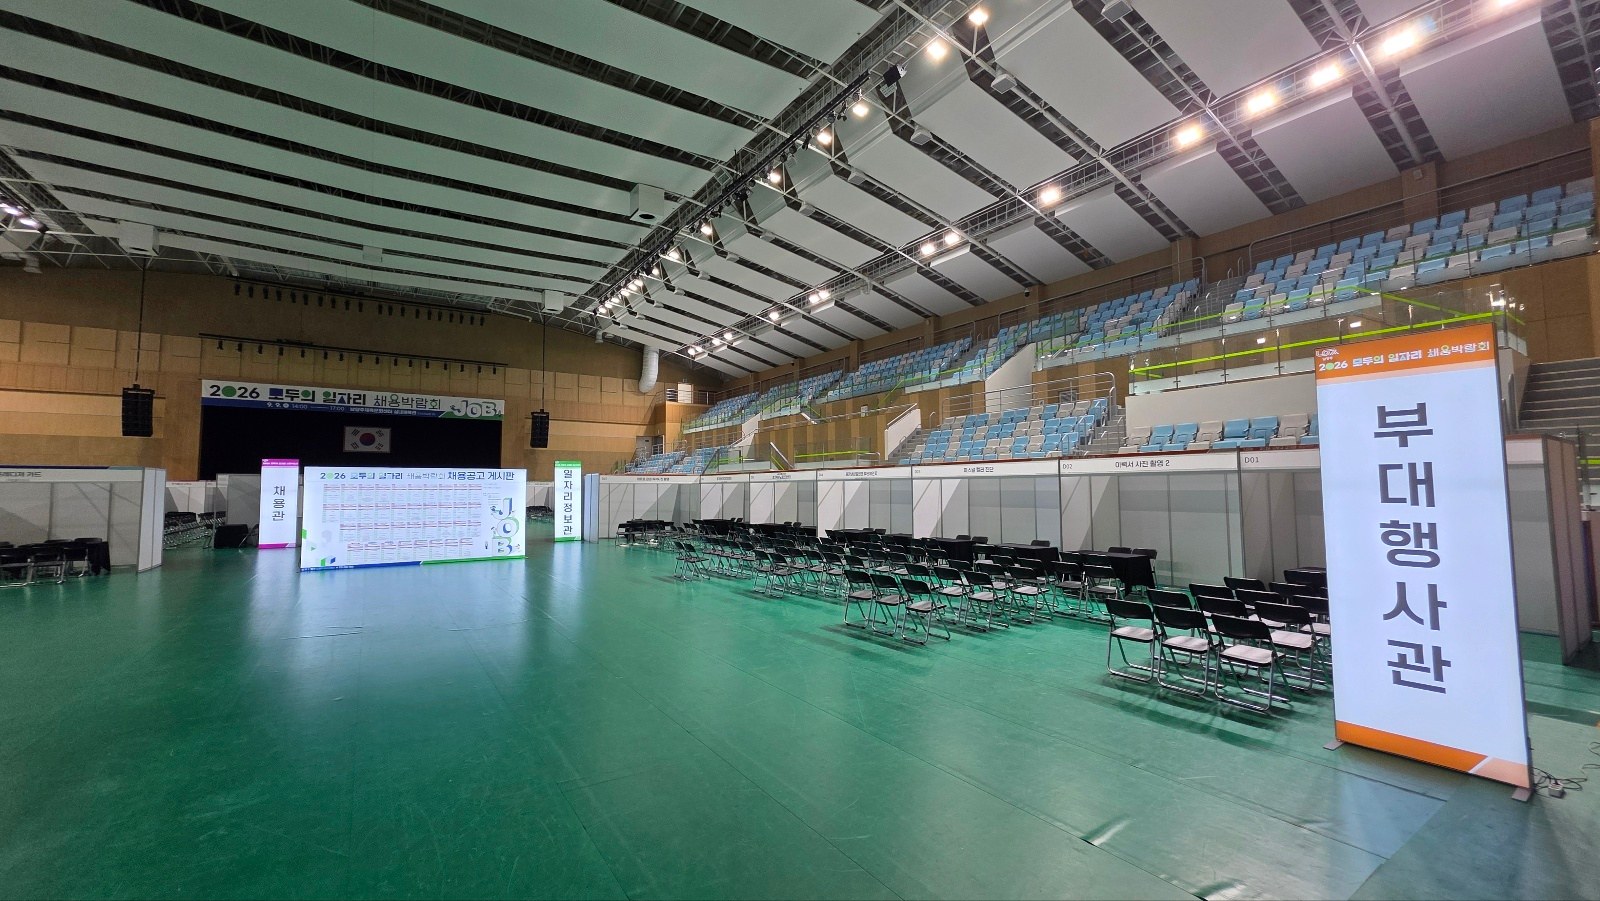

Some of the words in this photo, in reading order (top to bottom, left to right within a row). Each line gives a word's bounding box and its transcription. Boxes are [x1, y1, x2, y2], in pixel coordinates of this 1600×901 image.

[1318, 360, 1349, 372] 2026
[1352, 354, 1384, 367] 모두의
[1388, 350, 1422, 363] 일자리
[1427, 341, 1490, 358] 채용박람회
[209, 384, 260, 399] 2026
[268, 387, 316, 402] 모두의
[322, 390, 367, 405] 일자리
[373, 393, 441, 410] 채용박람회
[1114, 461, 1134, 469] 이력서
[1135, 460, 1149, 468] 사진
[1165, 459, 1170, 467] 2
[1244, 456, 1259, 464] D01
[319, 472, 346, 480] 2026
[447, 471, 485, 481] 채용공고
[487, 471, 515, 481] 게시판
[271, 485, 286, 522] 채용관
[563, 469, 573, 536] 일자리정보관
[1373, 402, 1452, 694] 부대행사관
